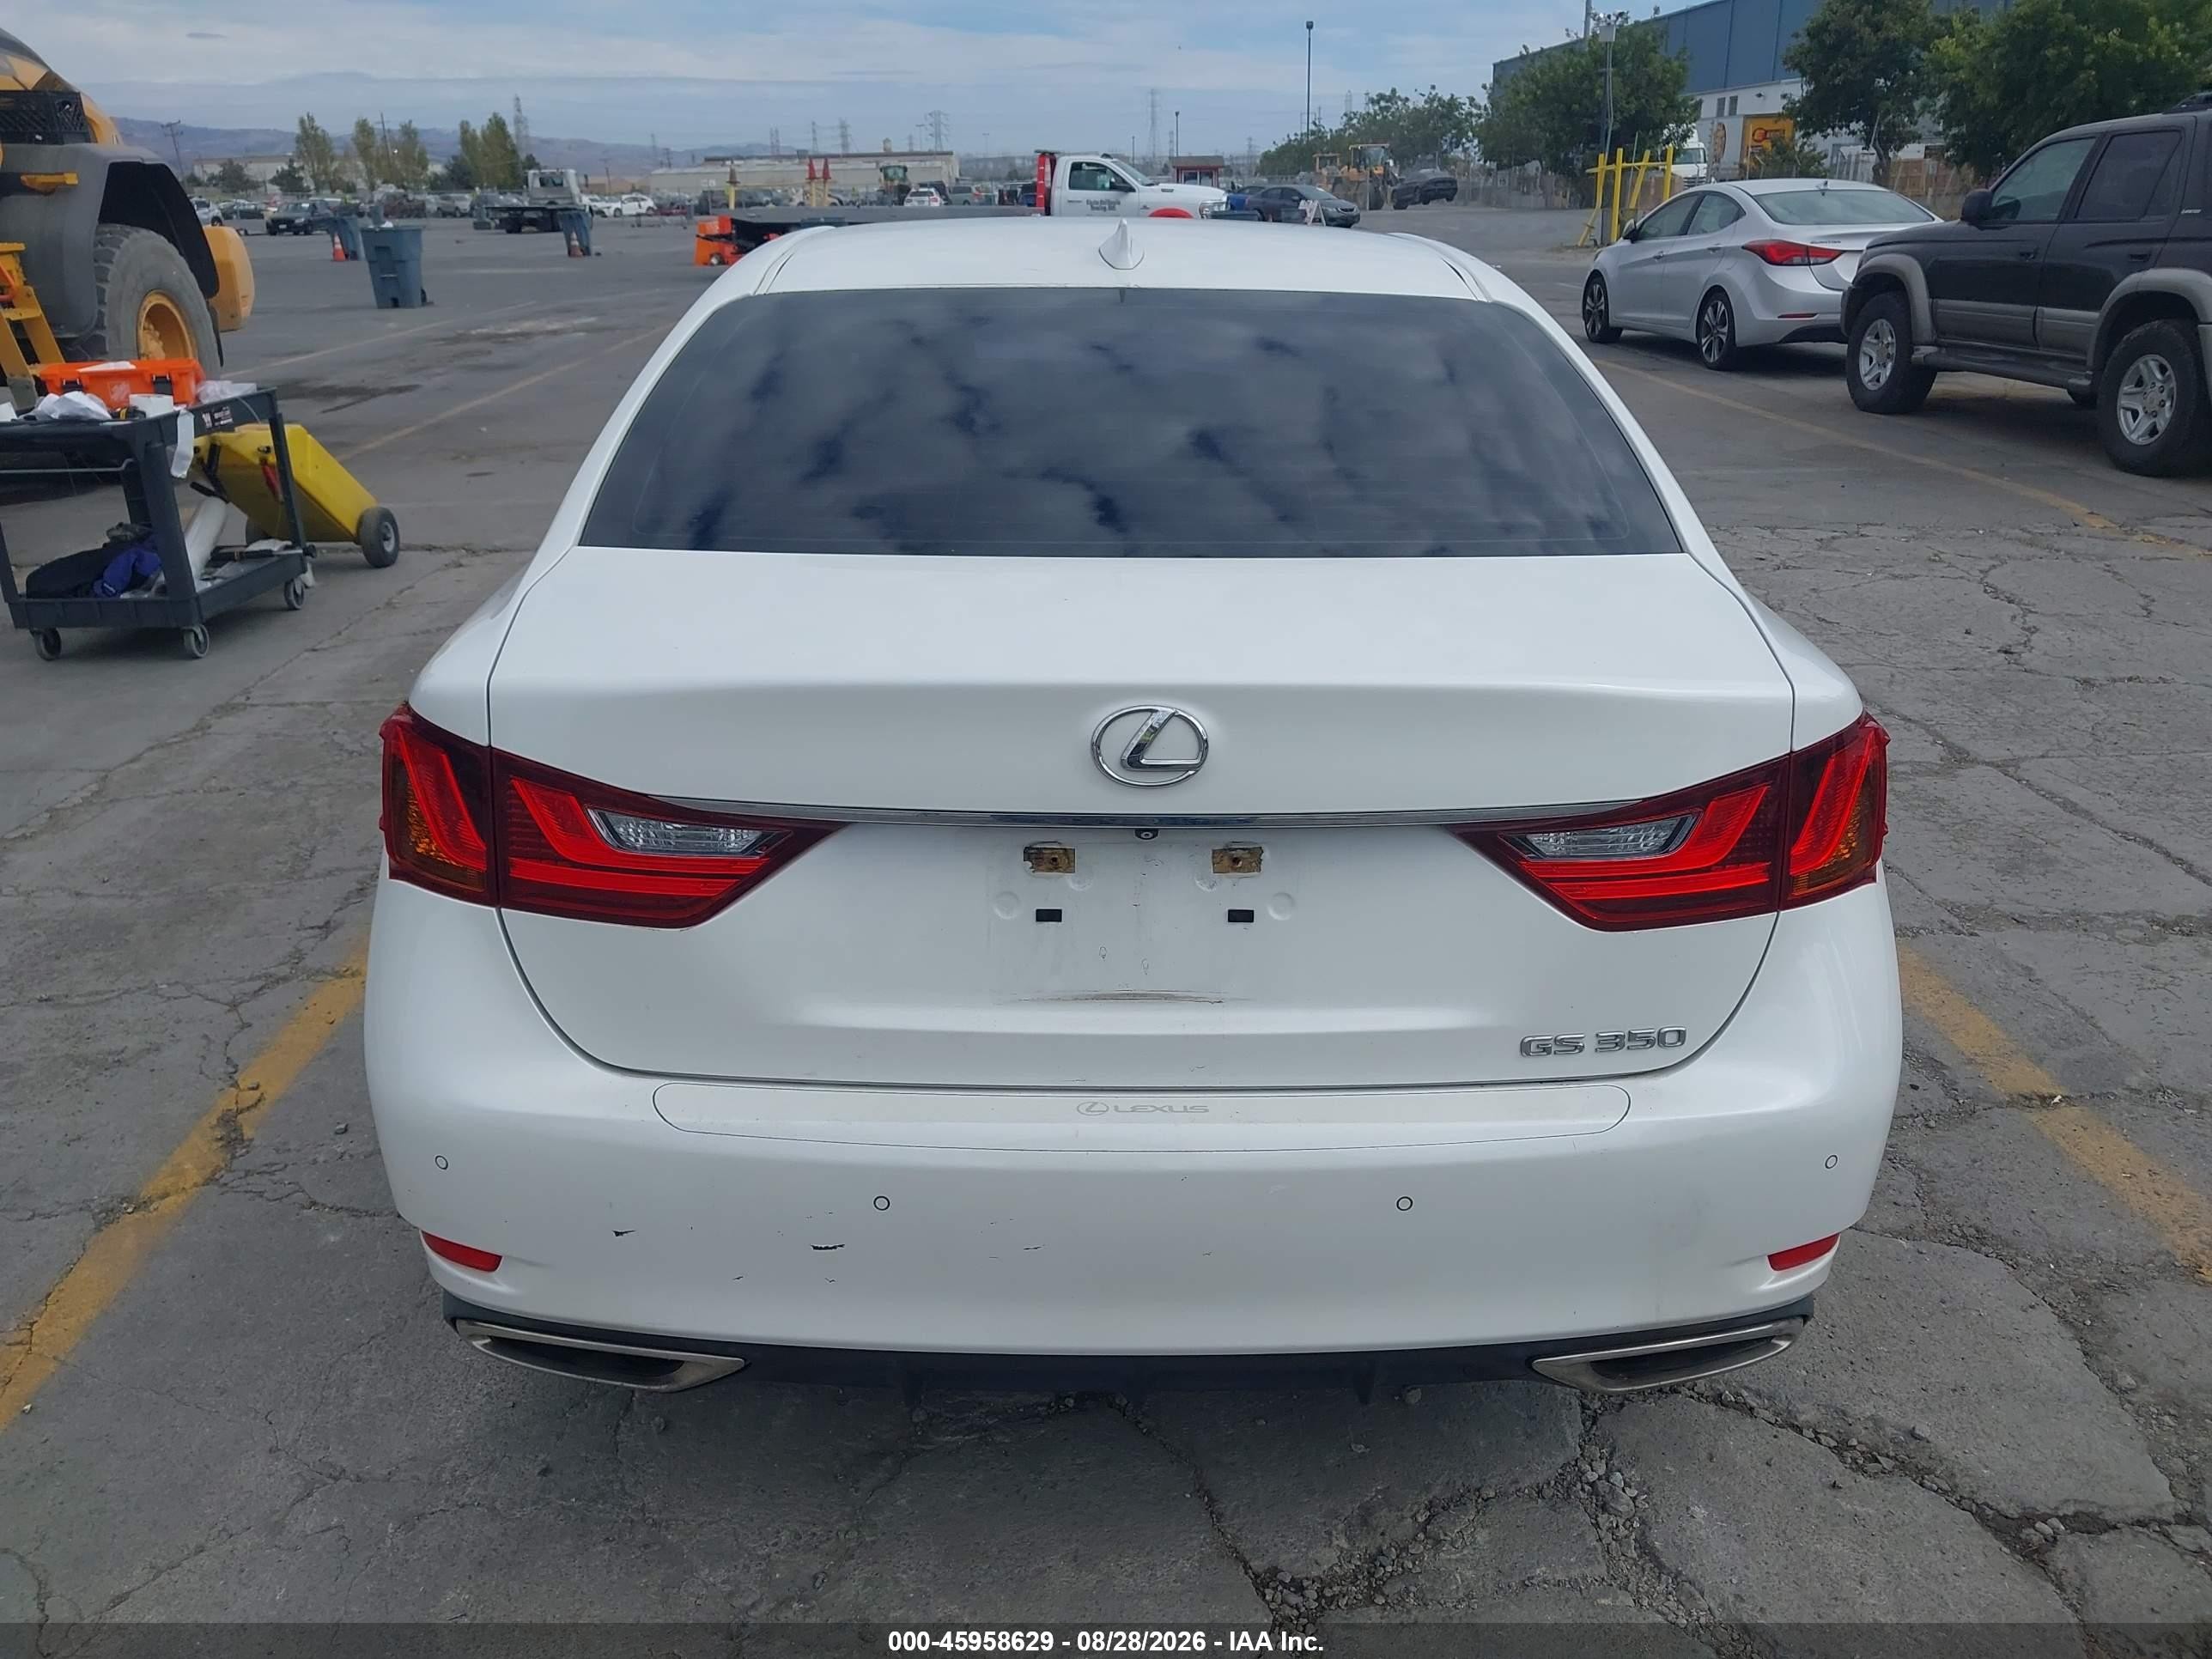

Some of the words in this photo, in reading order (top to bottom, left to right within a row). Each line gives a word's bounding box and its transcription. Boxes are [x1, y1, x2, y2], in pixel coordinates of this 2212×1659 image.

[1519, 1033, 1585, 1057] GS
[1595, 1025, 1687, 1053] 350
[1114, 1104, 1210, 1114] LEXUS
